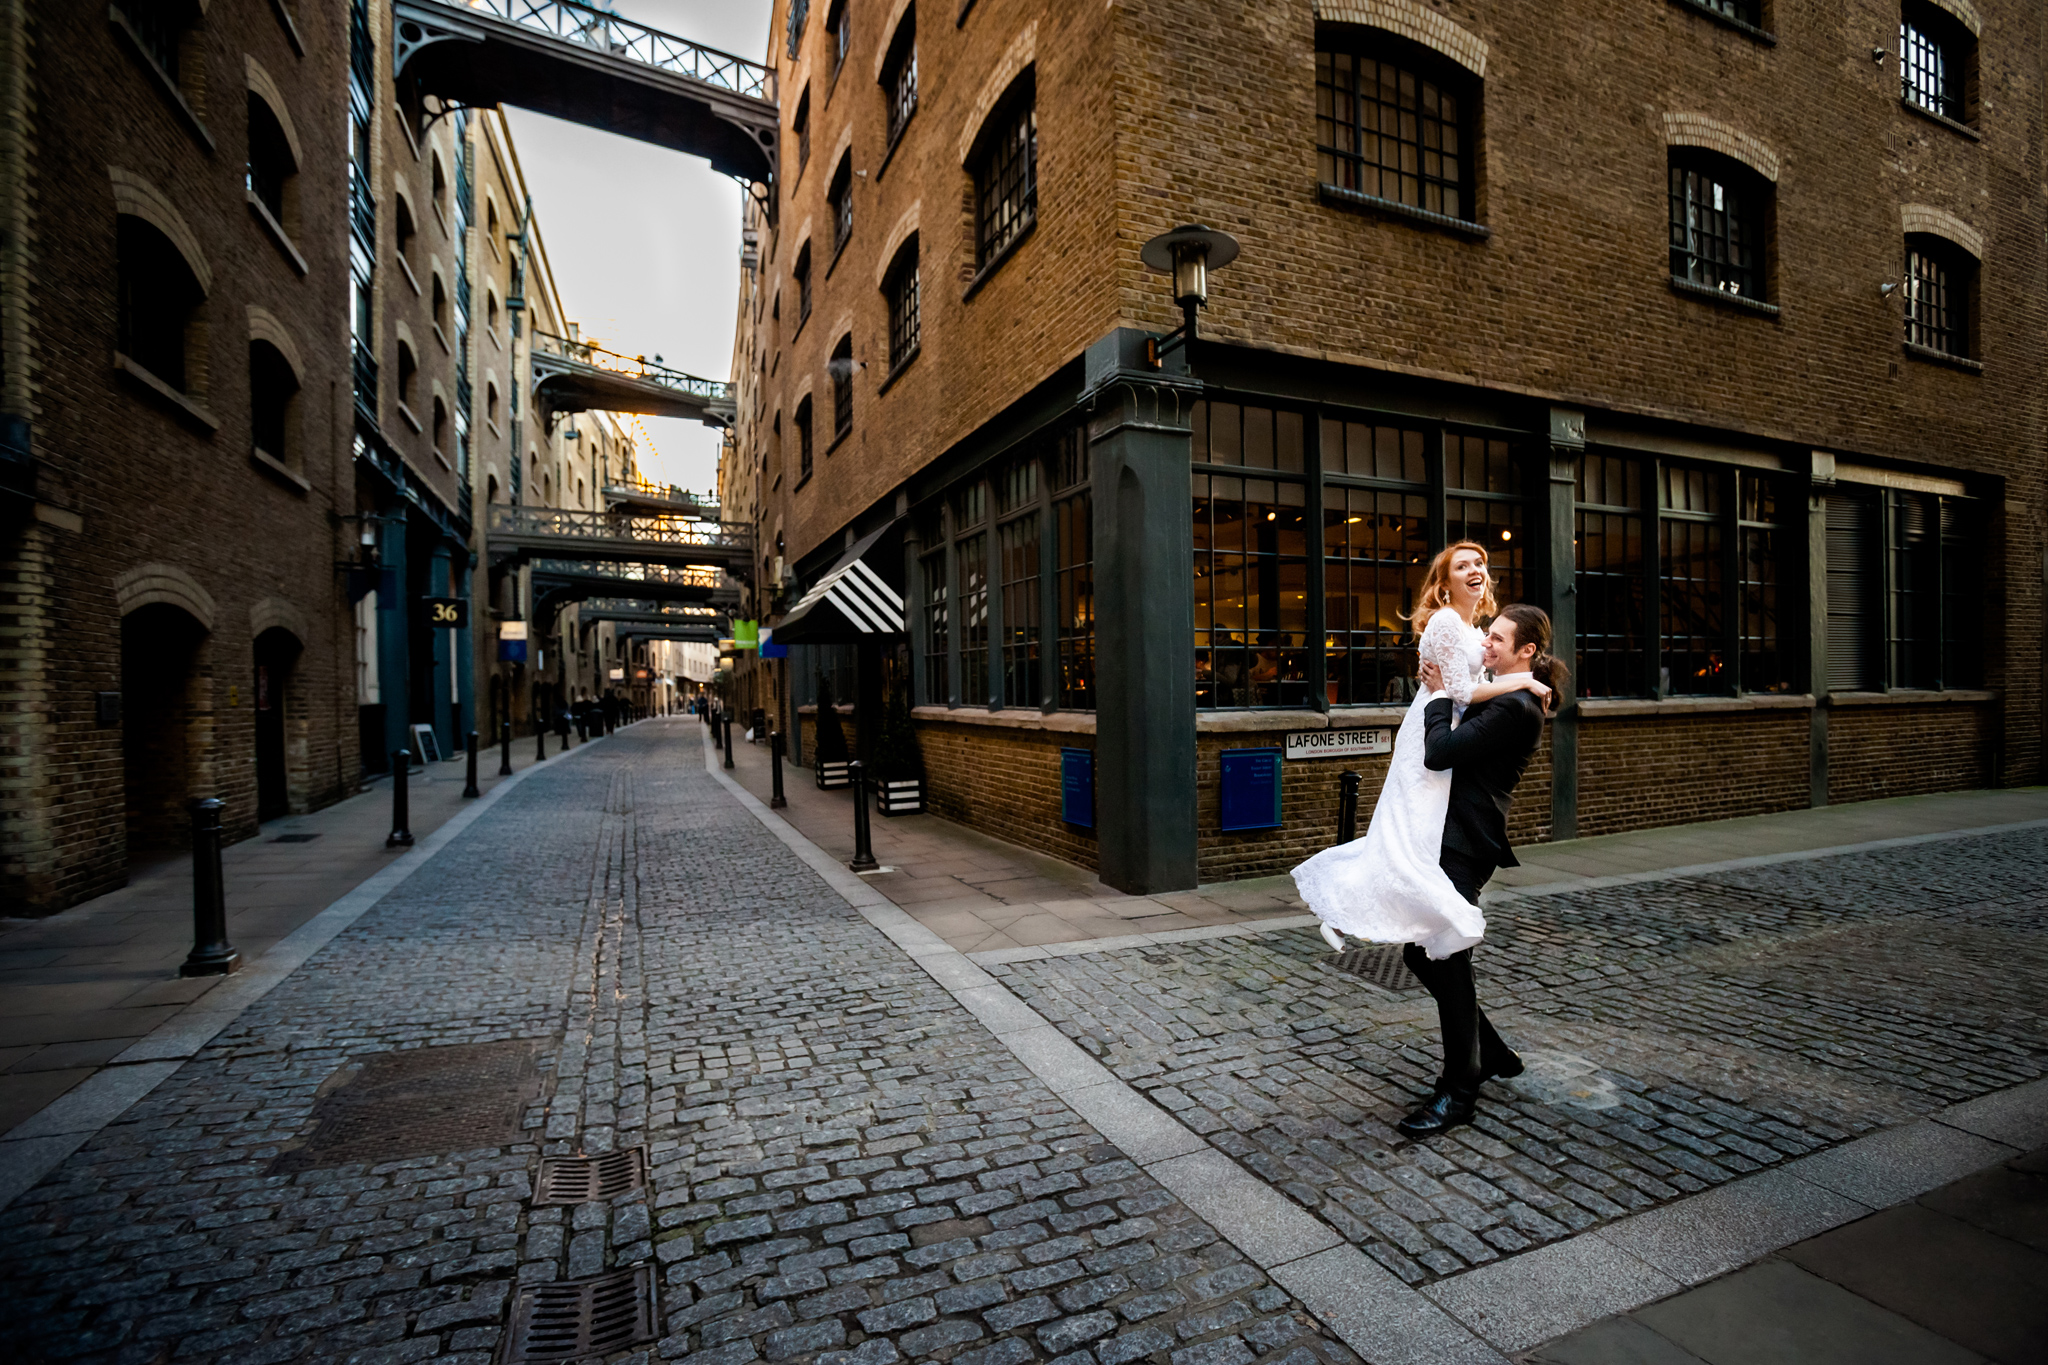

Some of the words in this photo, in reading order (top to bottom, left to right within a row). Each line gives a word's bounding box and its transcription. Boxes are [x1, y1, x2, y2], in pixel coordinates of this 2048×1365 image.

[432, 602, 458, 622] 36
[1288, 733, 1335, 748] LAFONE
[1338, 731, 1380, 746] STREET
